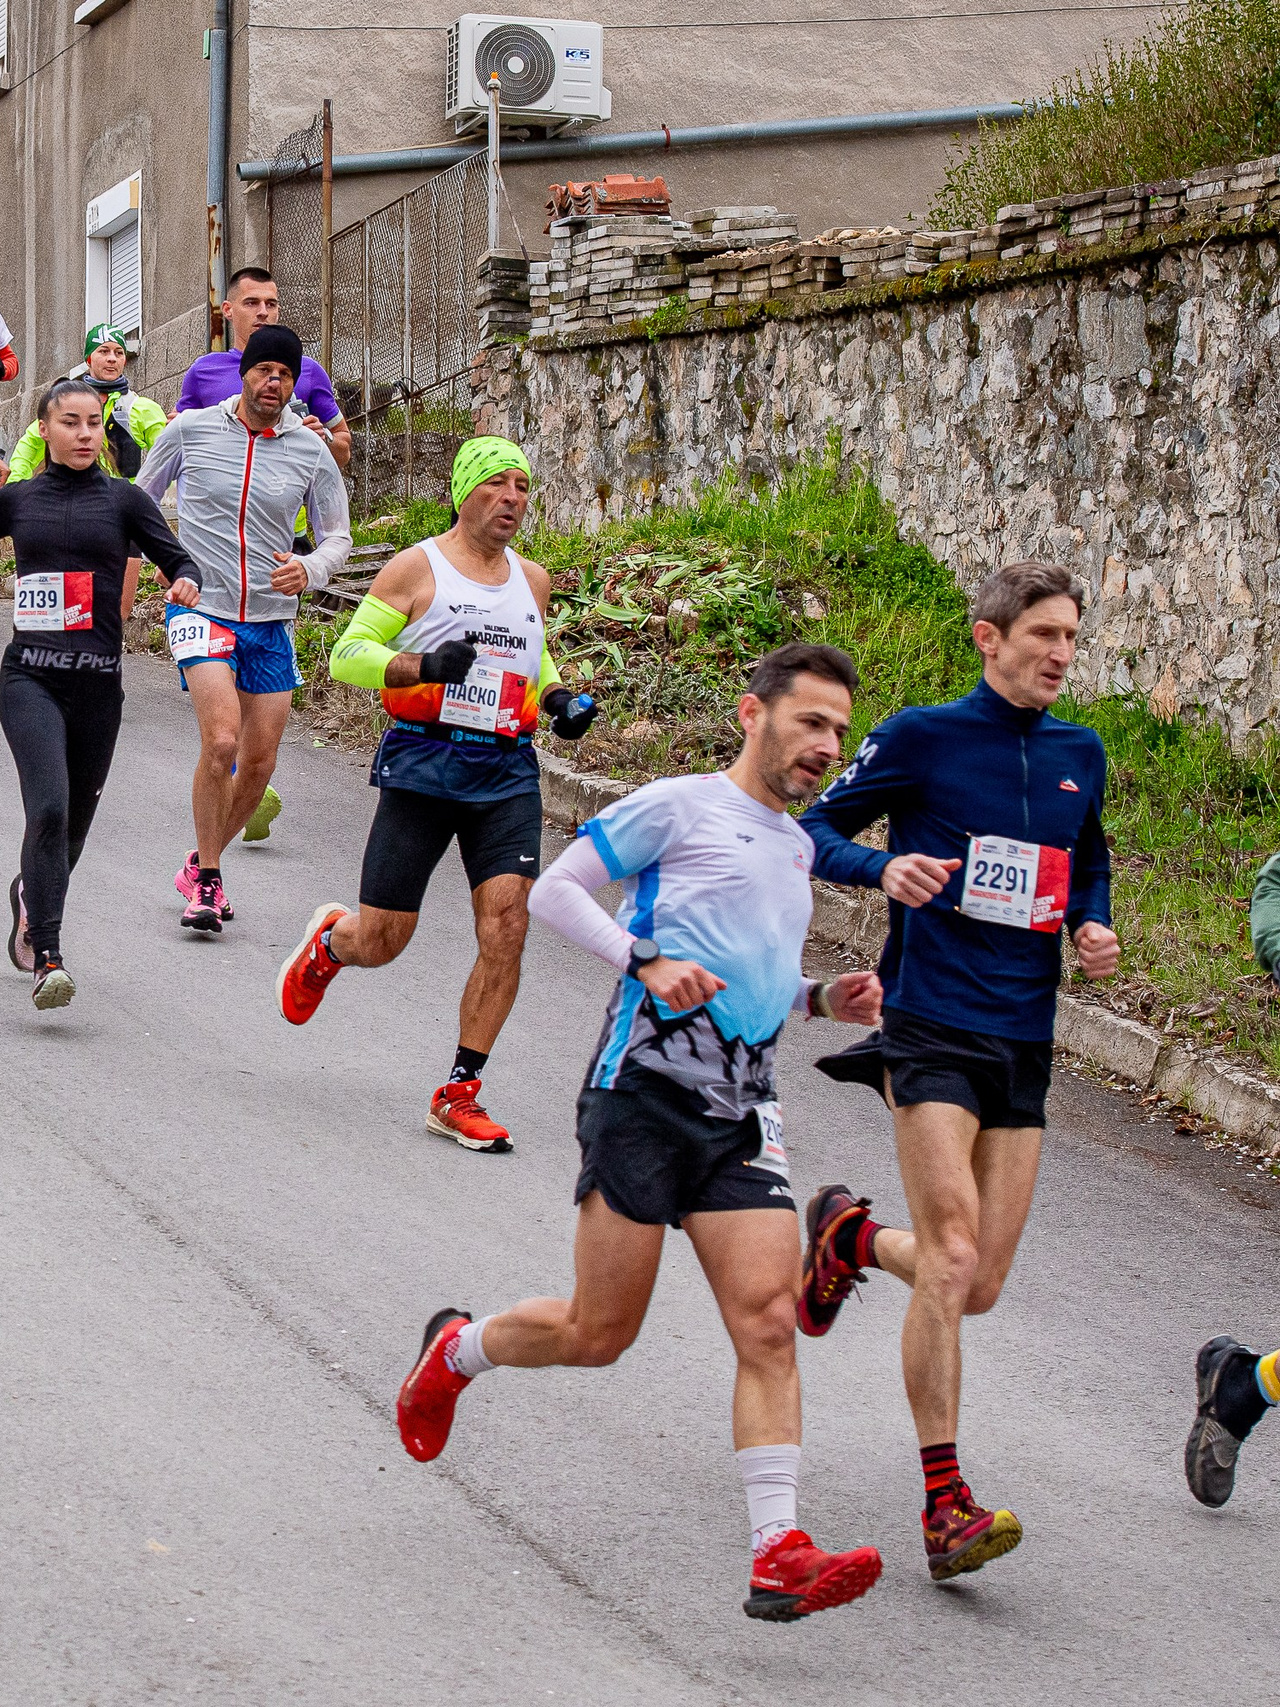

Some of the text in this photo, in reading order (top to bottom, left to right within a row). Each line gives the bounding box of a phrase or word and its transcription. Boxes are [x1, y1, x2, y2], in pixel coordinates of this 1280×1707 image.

[18, 590, 58, 609] 2139
[171, 626, 204, 646] 2331
[483, 624, 510, 634] VALENCIA
[464, 630, 527, 651] MARATHON
[21, 647, 75, 669] NIKE
[972, 860, 1028, 895] 2291
